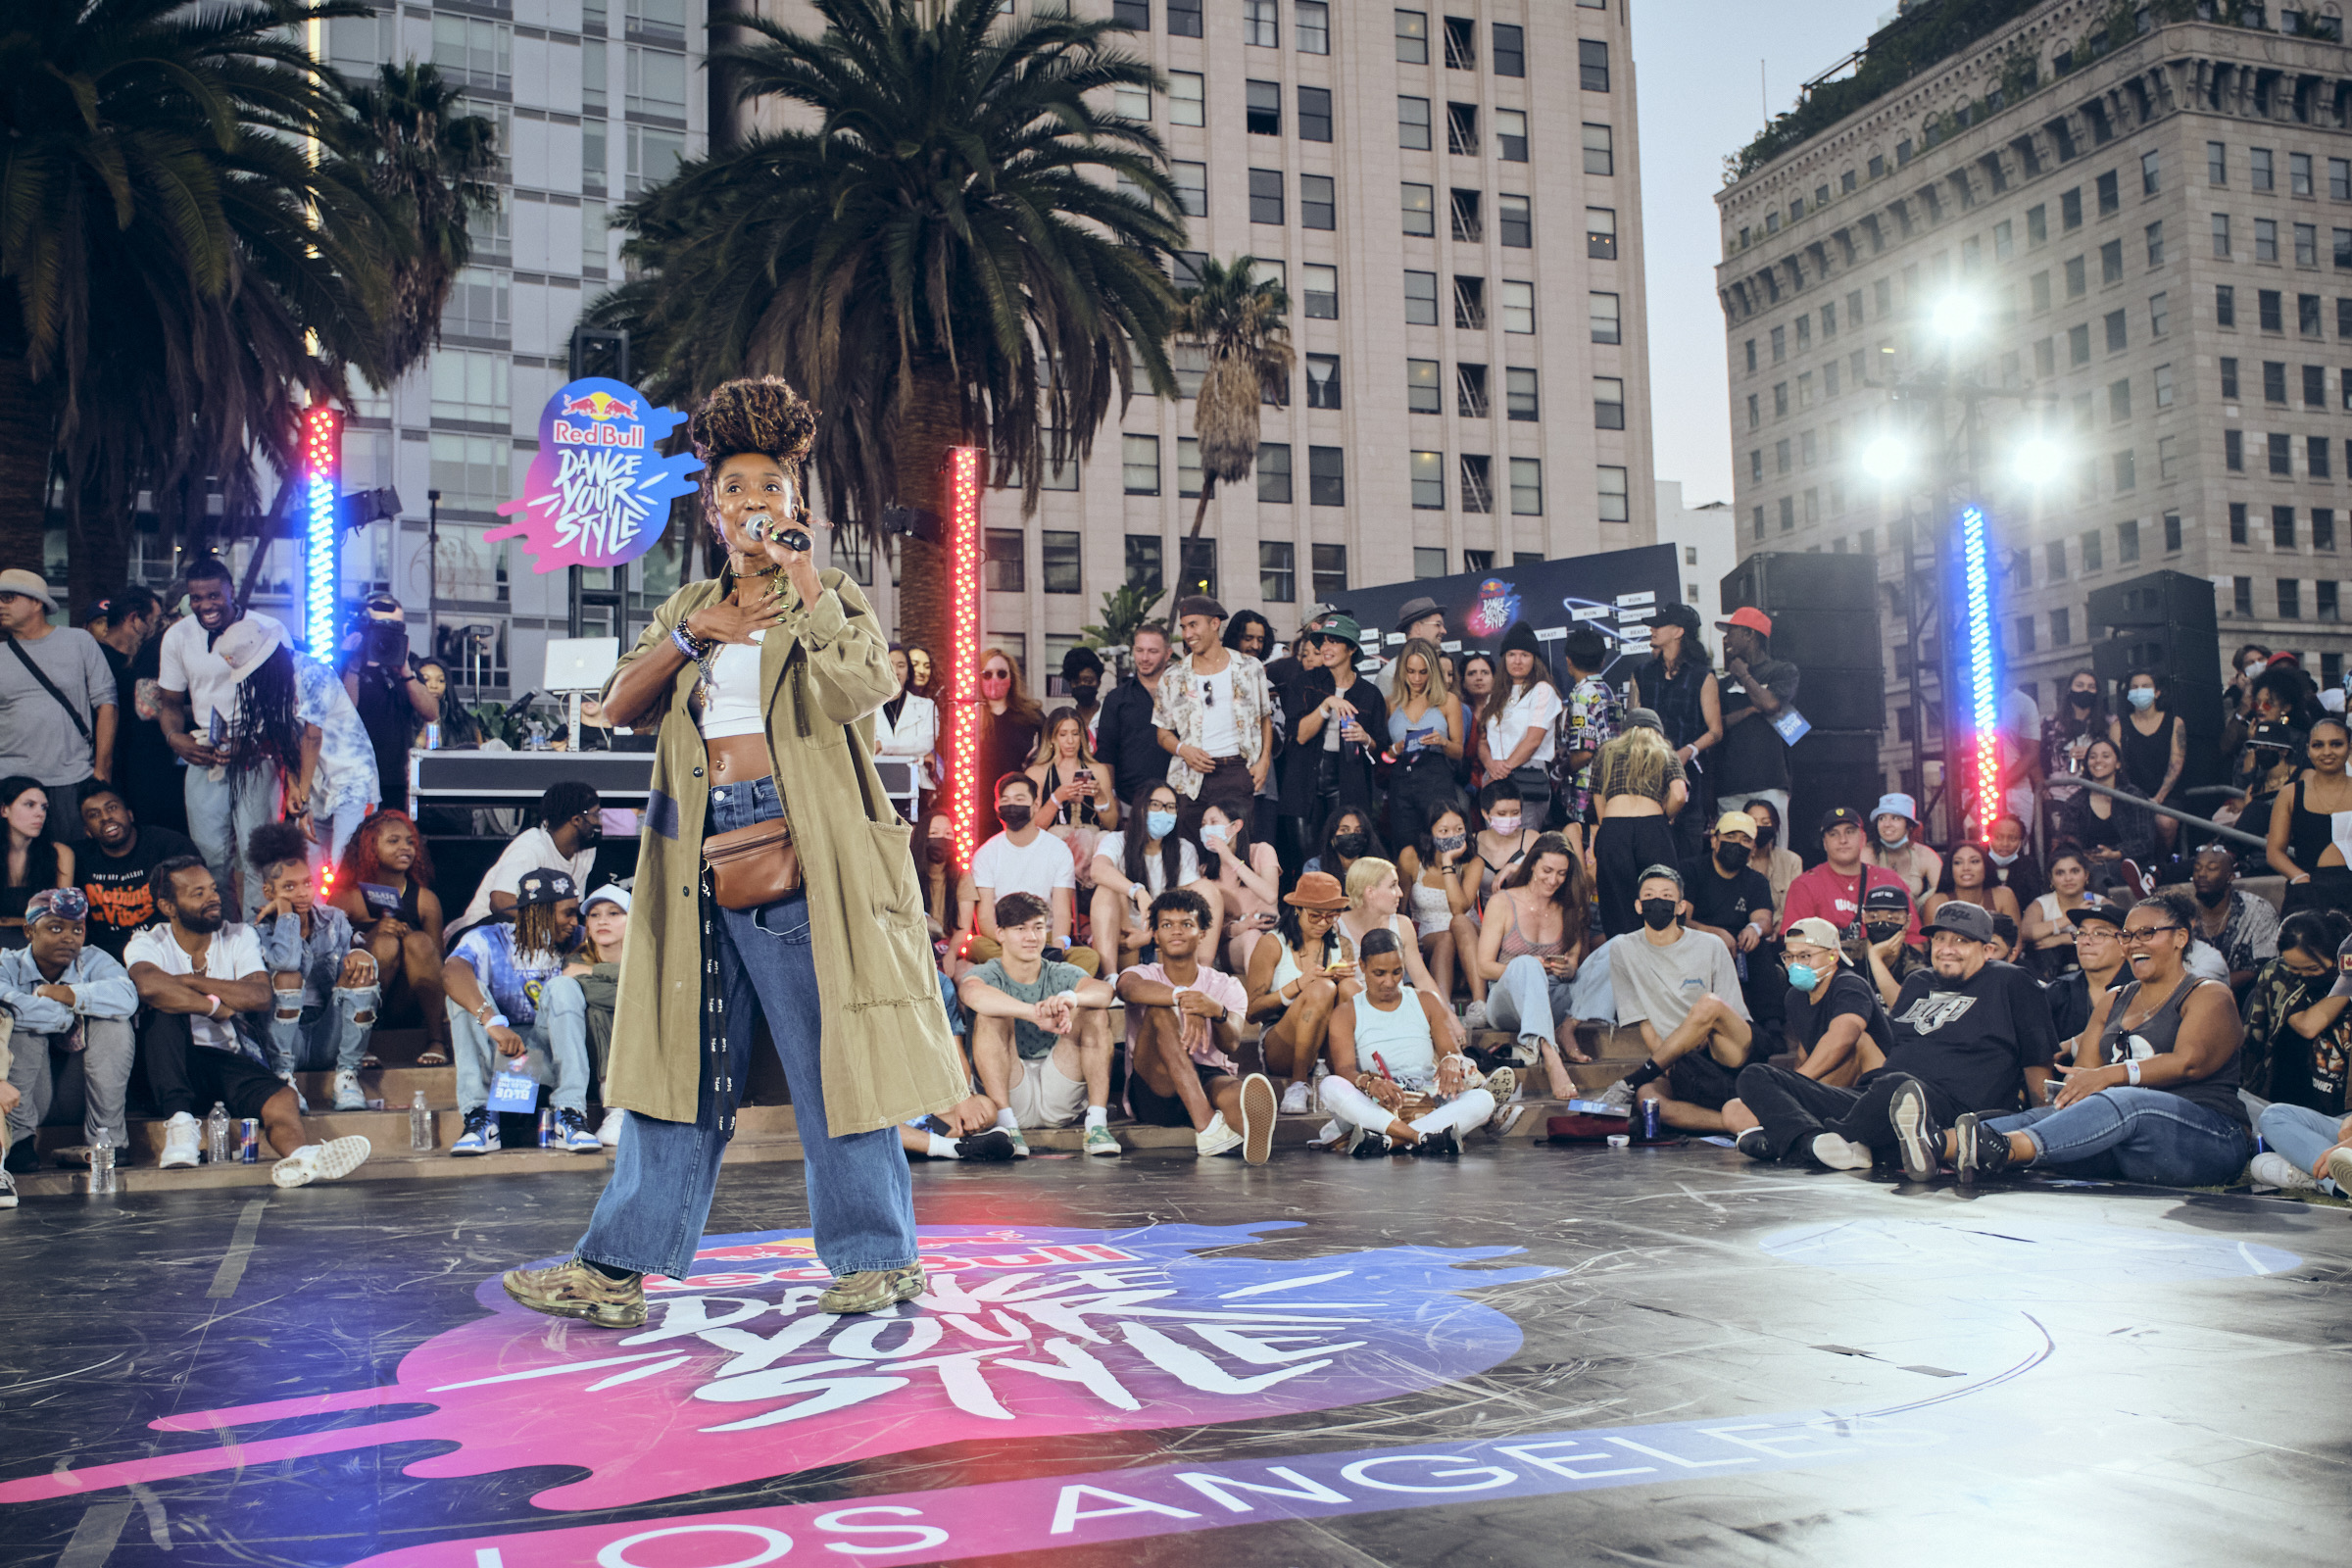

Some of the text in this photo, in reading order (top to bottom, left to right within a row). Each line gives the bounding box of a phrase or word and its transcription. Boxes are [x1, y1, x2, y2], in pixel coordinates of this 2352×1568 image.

[555, 420, 644, 448] Red Bull
[552, 448, 642, 488] DANCE
[559, 474, 650, 518] YOUR
[552, 501, 645, 558] STYLE
[84, 882, 153, 907] Nothing
[102, 903, 154, 927] Vibes
[495, 1087, 530, 1101] BLUE
[919, 1246, 1135, 1272] Bull
[694, 1321, 1368, 1432] STYLE
